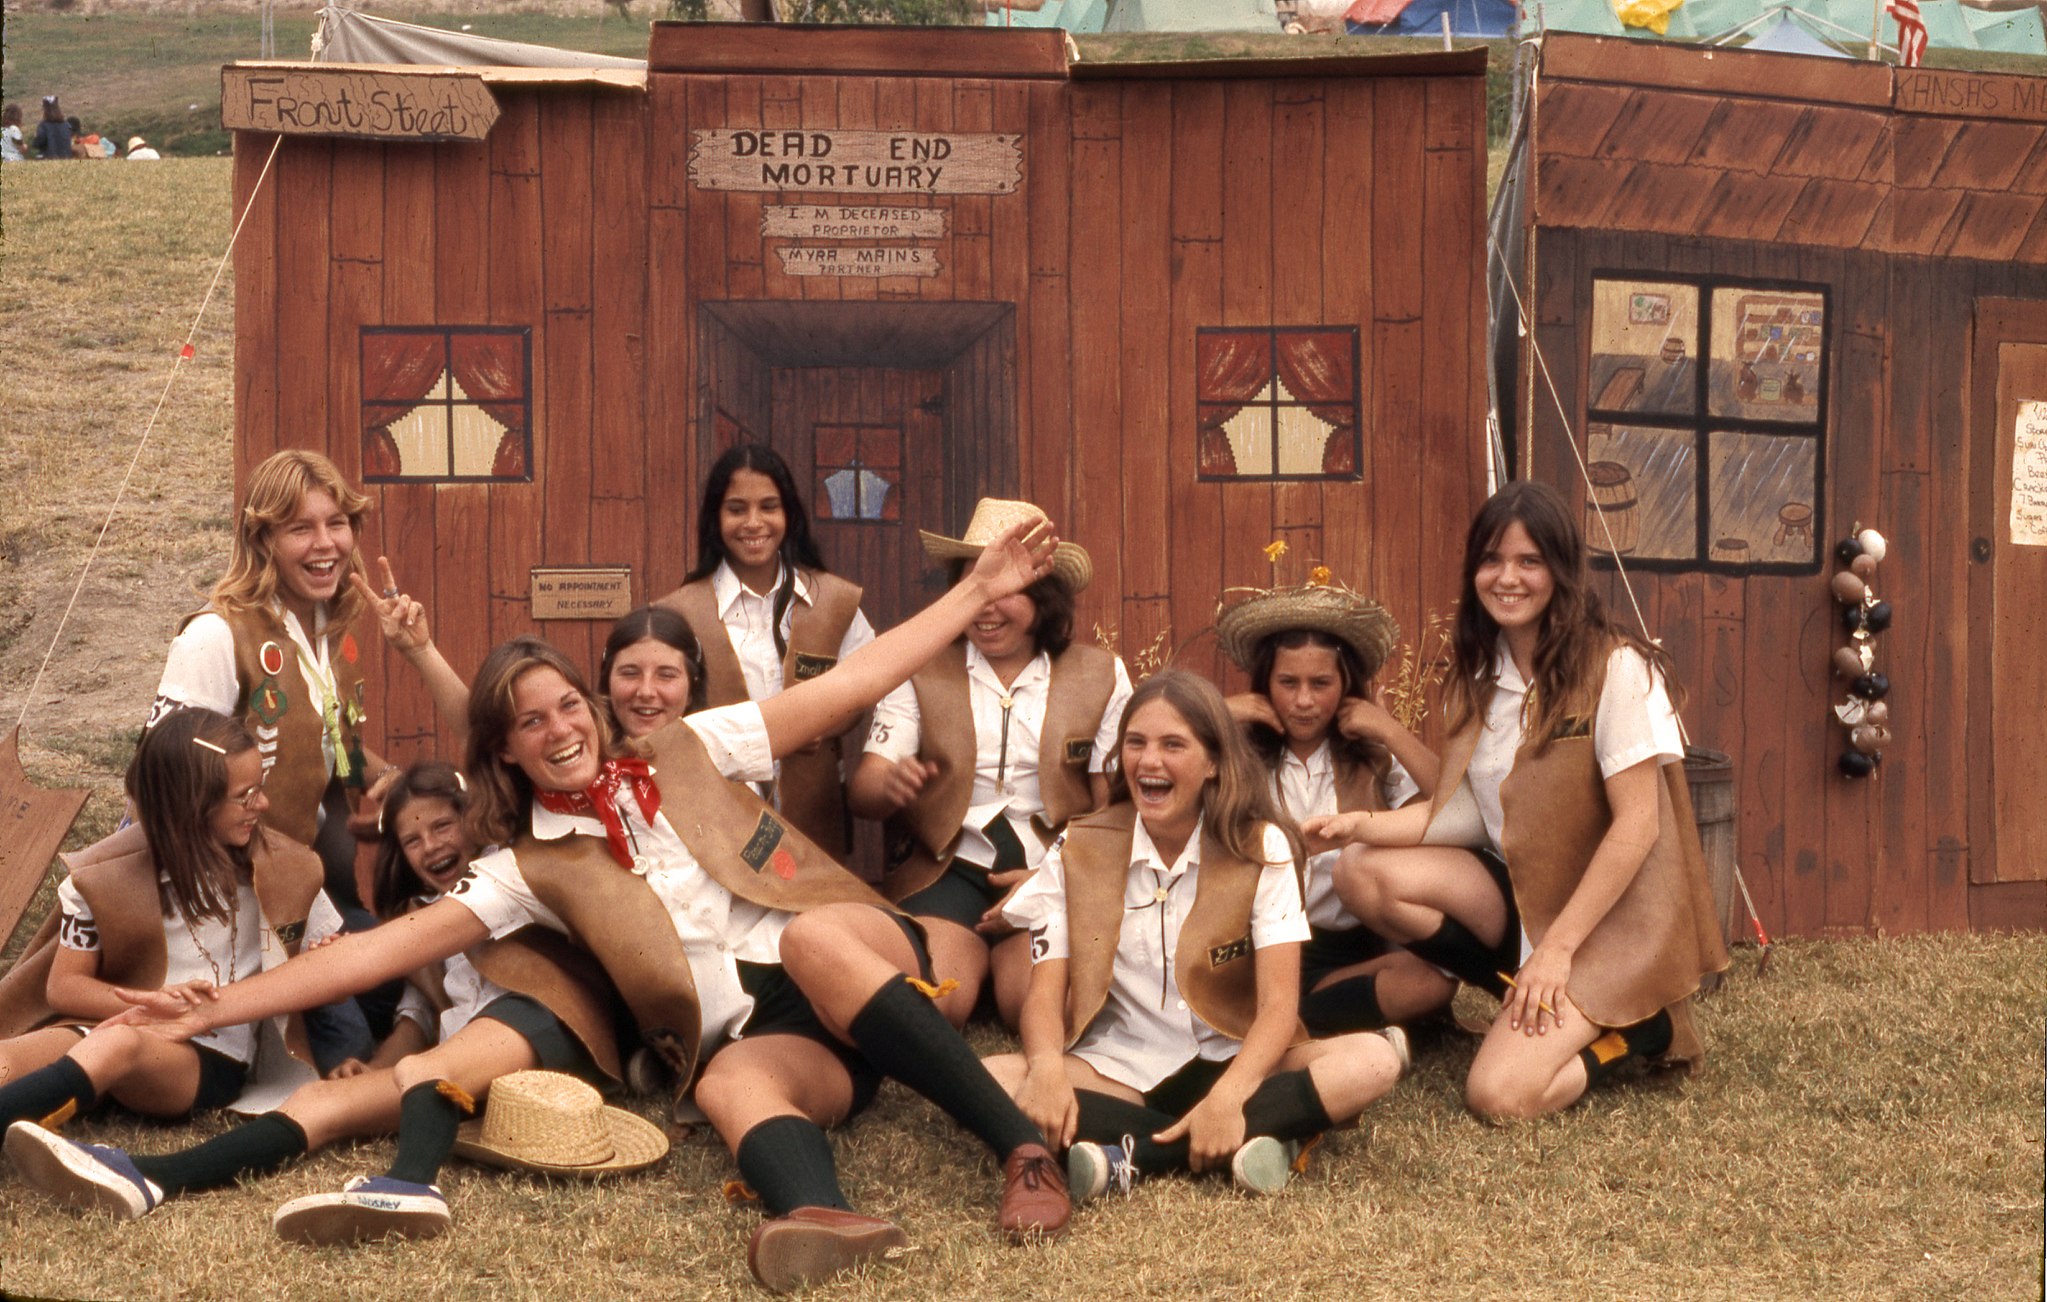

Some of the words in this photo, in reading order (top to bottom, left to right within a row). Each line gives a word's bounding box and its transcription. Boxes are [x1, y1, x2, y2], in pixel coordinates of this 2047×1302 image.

[1896, 73, 1999, 110] KANSAS
[731, 130, 832, 160] DEAD
[889, 137, 951, 161] END
[761, 162, 943, 189] MORTUARY
[838, 206, 921, 222] DECEASED
[812, 224, 900, 237] PROPRIETOR
[788, 248, 838, 262] MYRA
[856, 249, 921, 263] MAINS
[818, 264, 882, 275] PARTNER
[538, 582, 553, 592] NO
[558, 581, 622, 591] APPOINTMENT
[556, 600, 613, 610] NECESSARY
[62, 913, 99, 949] 75
